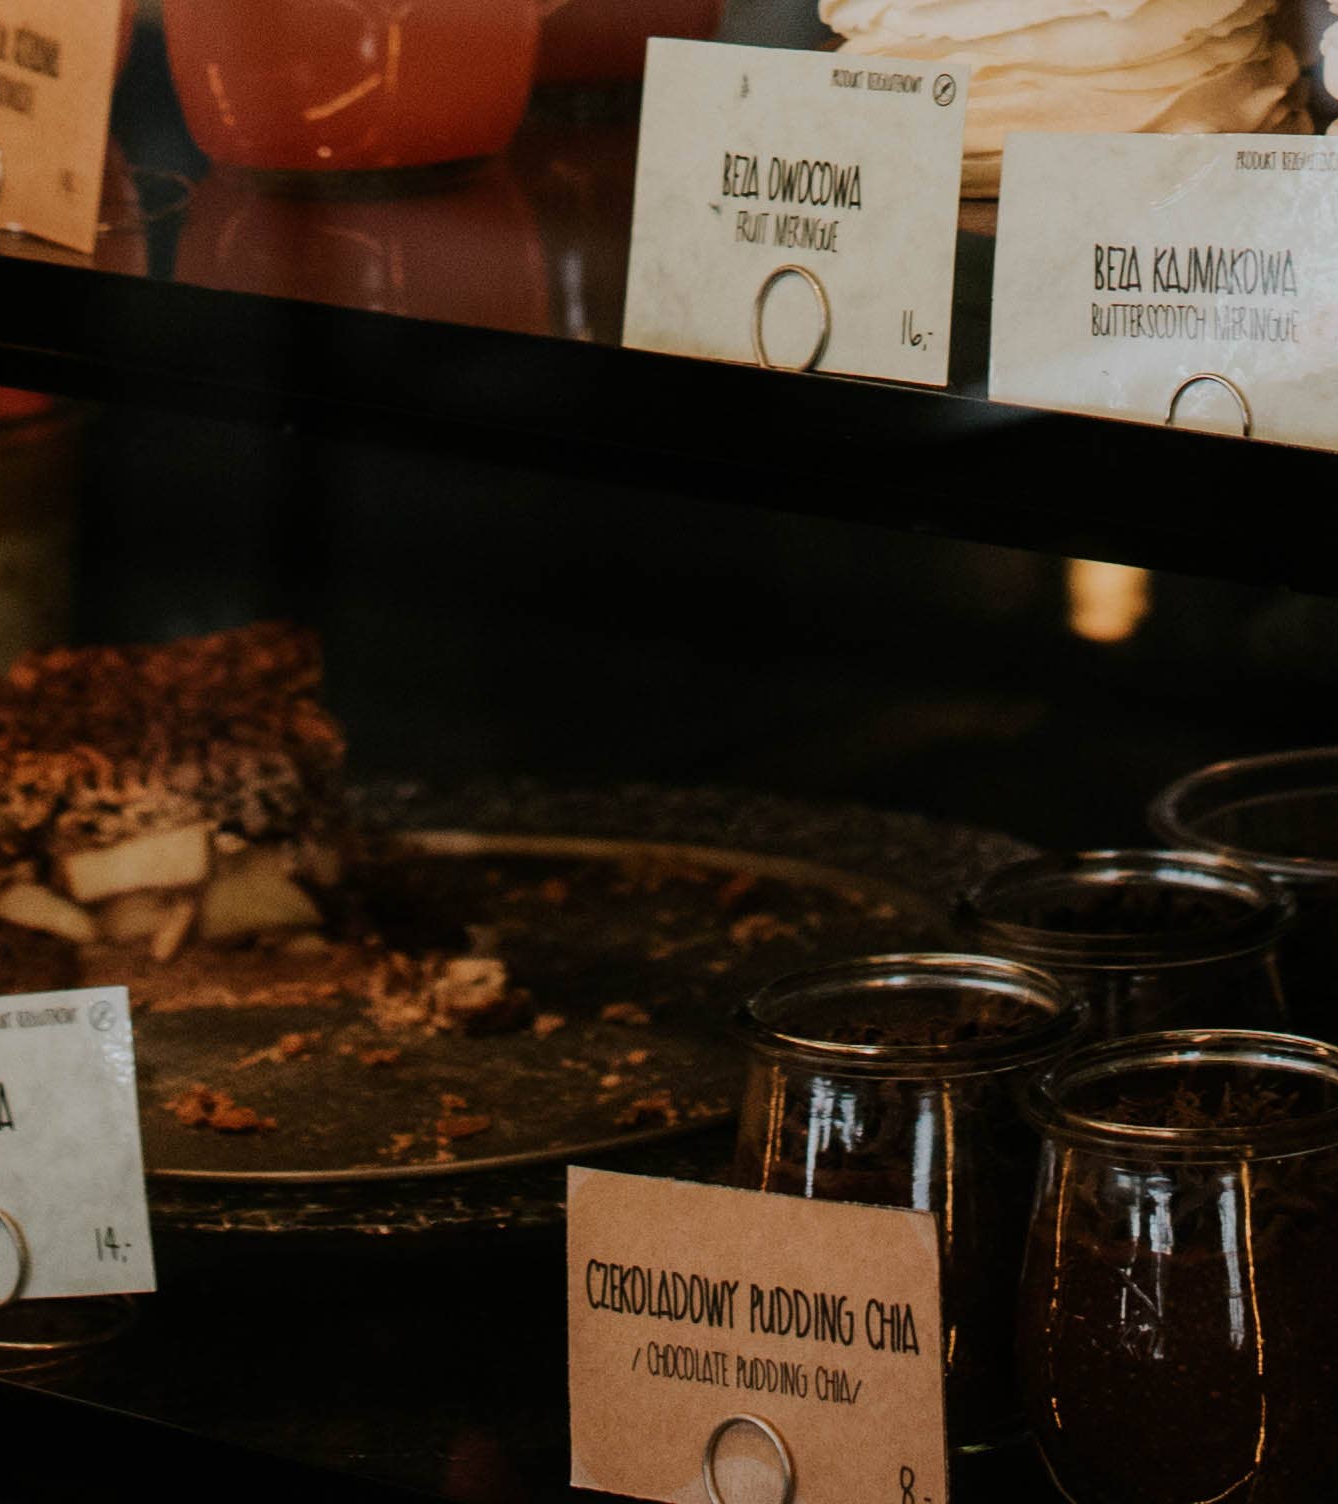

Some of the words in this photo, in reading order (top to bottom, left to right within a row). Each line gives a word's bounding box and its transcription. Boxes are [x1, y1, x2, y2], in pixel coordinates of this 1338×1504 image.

[722, 152, 759, 200] BEZA
[768, 157, 862, 210] OWOCOWA
[735, 210, 769, 244] FRUIT
[773, 215, 839, 253] MERINGUE
[1094, 243, 1142, 292] BEZA
[1153, 246, 1298, 296] KAJMAKOWA
[1091, 303, 1205, 340] BUTTERSCOTCH
[1215, 308, 1300, 344] MERINGUE
[586, 1258, 740, 1330] CZEKOLADOWY
[750, 1284, 854, 1347] PUDDING
[866, 1298, 920, 1356] CHIA
[647, 1341, 730, 1388] CHOCOLATE
[736, 1355, 808, 1399] PUDDING
